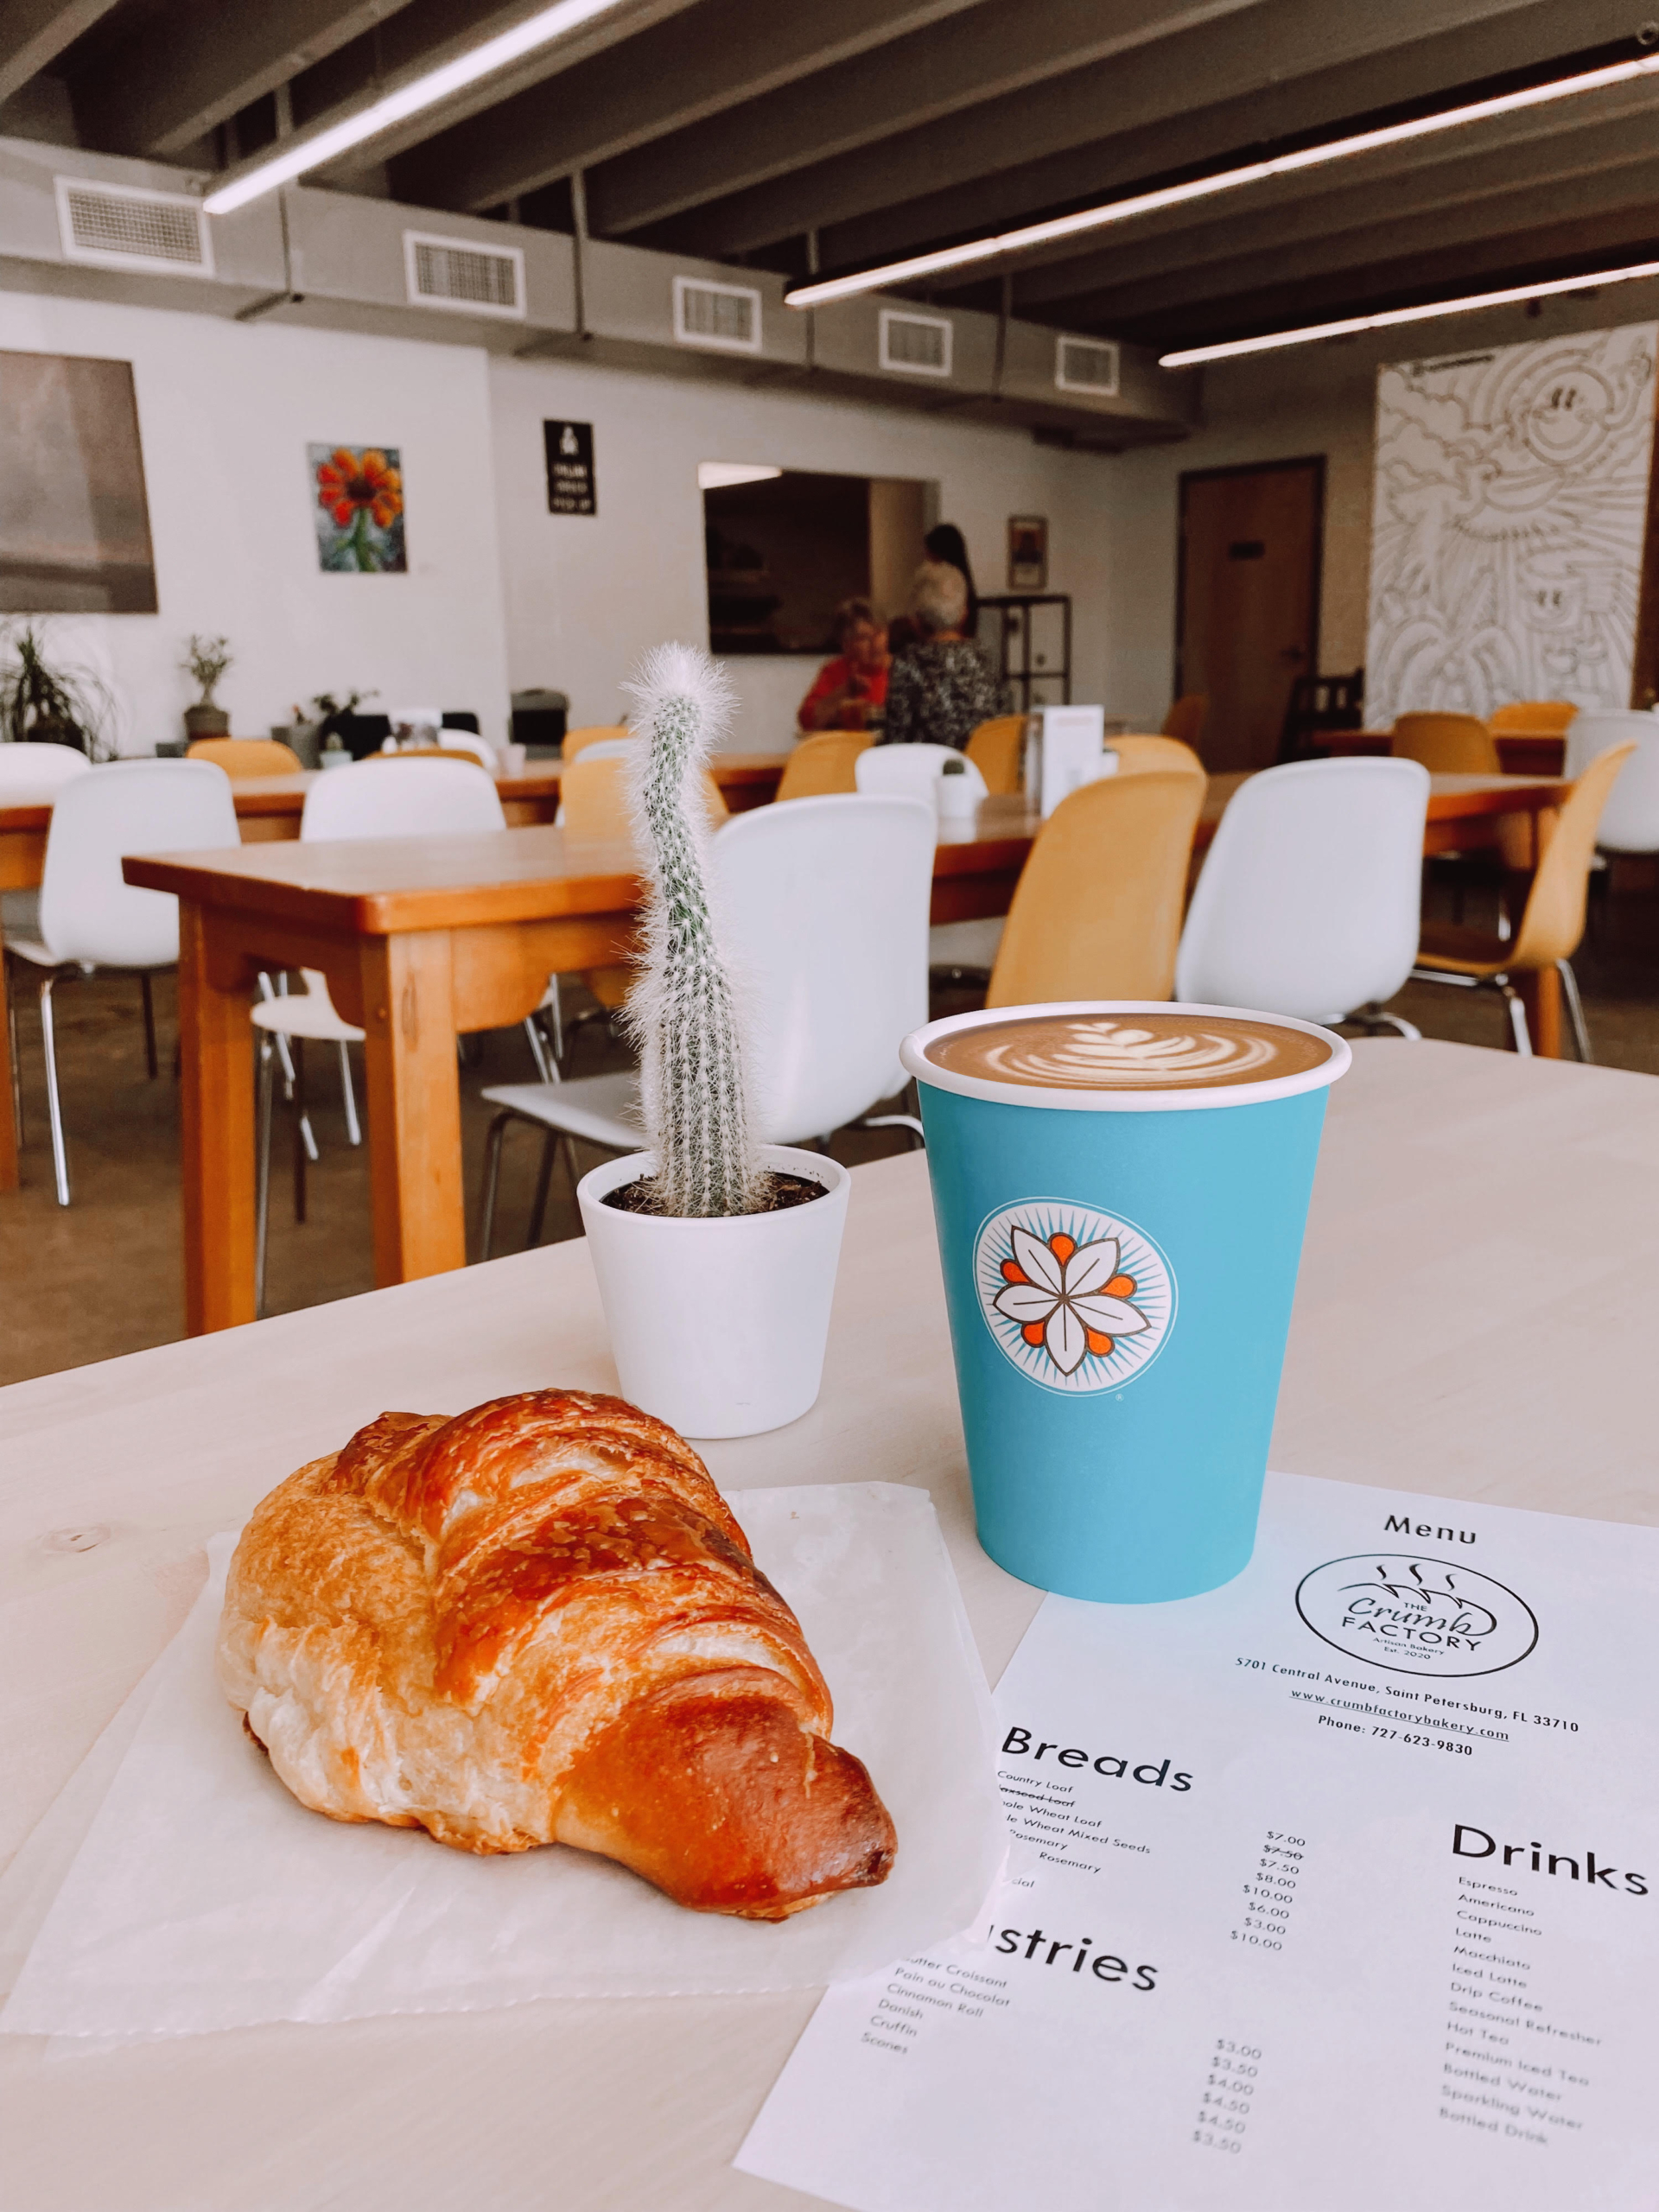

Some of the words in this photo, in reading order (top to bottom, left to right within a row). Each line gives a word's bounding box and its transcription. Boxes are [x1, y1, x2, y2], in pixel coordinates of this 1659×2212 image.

[1384, 1514, 1477, 1545] Menu
[1348, 1597, 1482, 1637] Crumb
[1403, 1602, 1427, 1612] THE
[1341, 1616, 1482, 1652] FACTORY
[1372, 1637, 1407, 1649] Artisan
[1409, 1643, 1446, 1656] Bakery
[1383, 1646, 1401, 1656] Est.
[1403, 1650, 1431, 1660] 2020
[1235, 1656, 1267, 1670] 5701
[1272, 1663, 1320, 1681] Central
[1324, 1674, 1380, 1694] Avenue,
[1385, 1686, 1420, 1700] Saint
[1424, 1694, 1508, 1719] Petersburg,
[1513, 1711, 1528, 1723] FL
[1533, 1715, 1580, 1732] 33710
[1289, 1689, 1510, 1742] www.crumbfactorybakery.com
[1318, 1714, 1366, 1734] Phone:
[1370, 1726, 1473, 1757] 727-623-9830
[1001, 1726, 1194, 1792] Breads
[997, 1770, 1043, 1789] Country
[1046, 1781, 1075, 1795] Loaf
[1002, 1800, 1025, 1811] ole
[1029, 1804, 1071, 1822] Wheat
[1073, 1815, 1103, 1829] Loaf
[1047, 1796, 1076, 1808] Loaf
[1023, 1817, 1065, 1835] Wheat
[1068, 1829, 1109, 1846] Mixed
[1112, 1838, 1152, 1855] Seeds
[1267, 1831, 1306, 1847] $7.00
[1039, 1851, 1103, 1875] Rosemary
[1262, 1845, 1303, 1860] $7.50
[1452, 1824, 1649, 1896] Drinks
[1259, 1859, 1300, 1875] $7.50
[1255, 1872, 1296, 1889] $8.00
[1459, 1877, 1518, 1897] Espresso
[1243, 1885, 1293, 1904] $10.00
[1458, 1894, 1535, 1916] Americano
[1248, 1902, 1290, 1920] $6.00
[1456, 1910, 1543, 1936] Cappuccino
[1244, 1917, 1287, 1936] $3.00
[1455, 1927, 1492, 1944] Latte
[1230, 1930, 1283, 1952] $10.00
[1453, 1946, 1531, 1972] Macchiato
[894, 1967, 924, 1984] Pain
[928, 1979, 945, 1989] au
[950, 1982, 1010, 2007] Chocolat
[946, 1964, 1007, 1988] Croissant
[1452, 1964, 1483, 1980] Iced
[1490, 1972, 1528, 1989] Latte
[878, 1998, 924, 2020] Danish
[887, 1983, 953, 2010] Cinnamon
[957, 2003, 984, 2018] Roll
[1451, 1981, 1483, 1998] Drip
[1489, 1991, 1543, 2012] Coffee
[870, 2014, 918, 2037] Cruffin
[1447, 2020, 1474, 2036] Hot
[1480, 2029, 1510, 2045] Tea
[1449, 2000, 1521, 2026] Seasonal
[1526, 2018, 1601, 2045] Refresher
[861, 2031, 908, 2055] Scones
[1445, 2041, 1513, 2067] Premium
[1517, 2060, 1553, 2077] Iced
[1558, 2069, 1590, 2087] Tea
[1443, 2062, 1501, 2086] Bottled
[1507, 2078, 1562, 2101] Water
[1439, 2106, 1499, 2133] Bottled
[1441, 2083, 1520, 2117] Sparkling
[1526, 2105, 1583, 2131] Water
